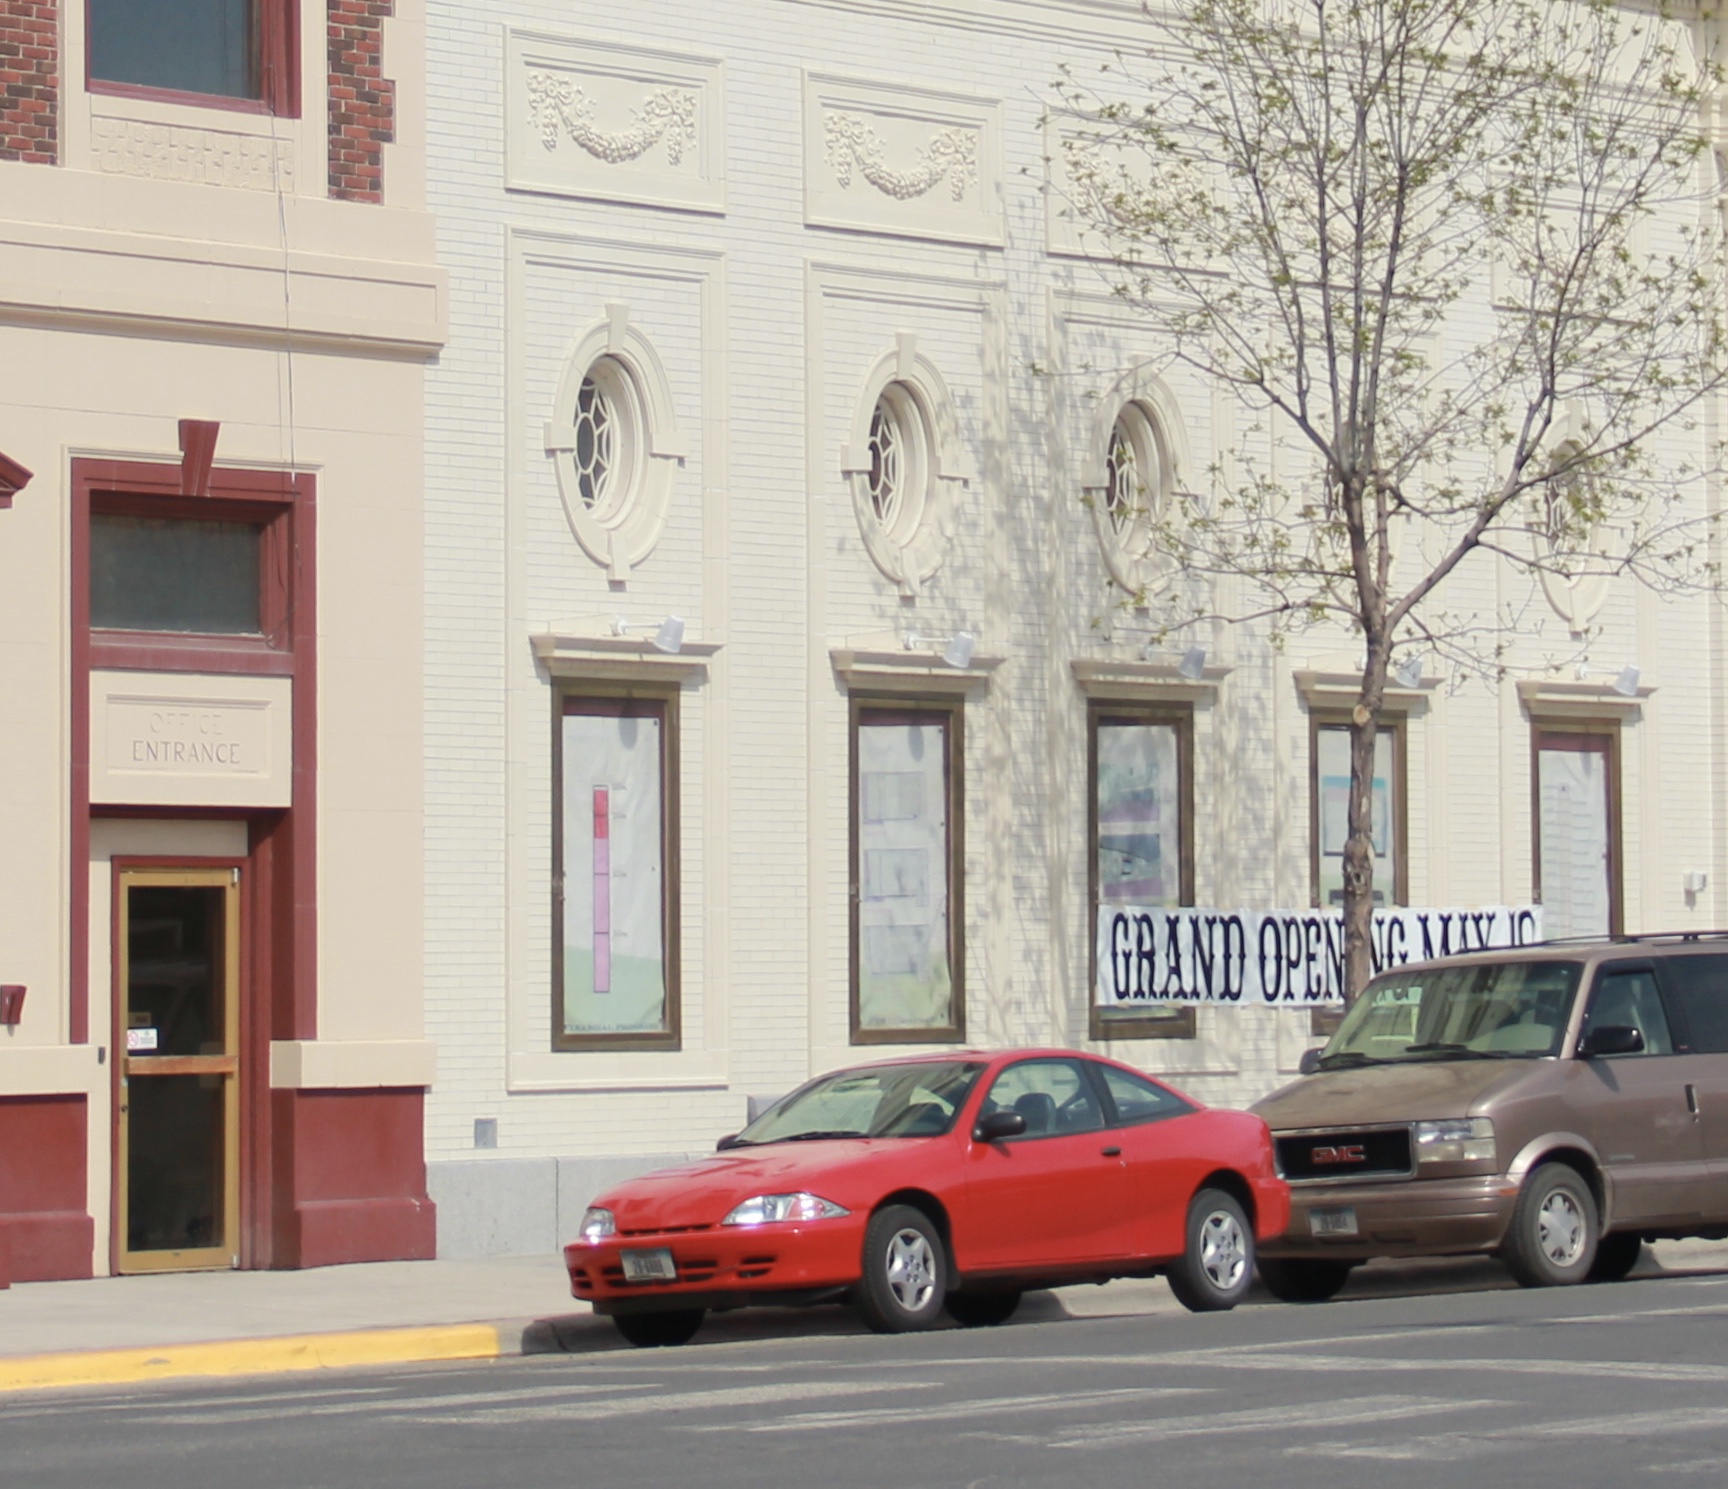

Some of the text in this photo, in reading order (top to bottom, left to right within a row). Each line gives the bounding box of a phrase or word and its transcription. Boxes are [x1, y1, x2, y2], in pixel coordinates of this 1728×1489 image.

[132, 740, 241, 764] ENTRANCE
[1110, 911, 1246, 1002] GRAND
[1258, 913, 1408, 1002] OPENNG
[1311, 1144, 1366, 1164] GMC
